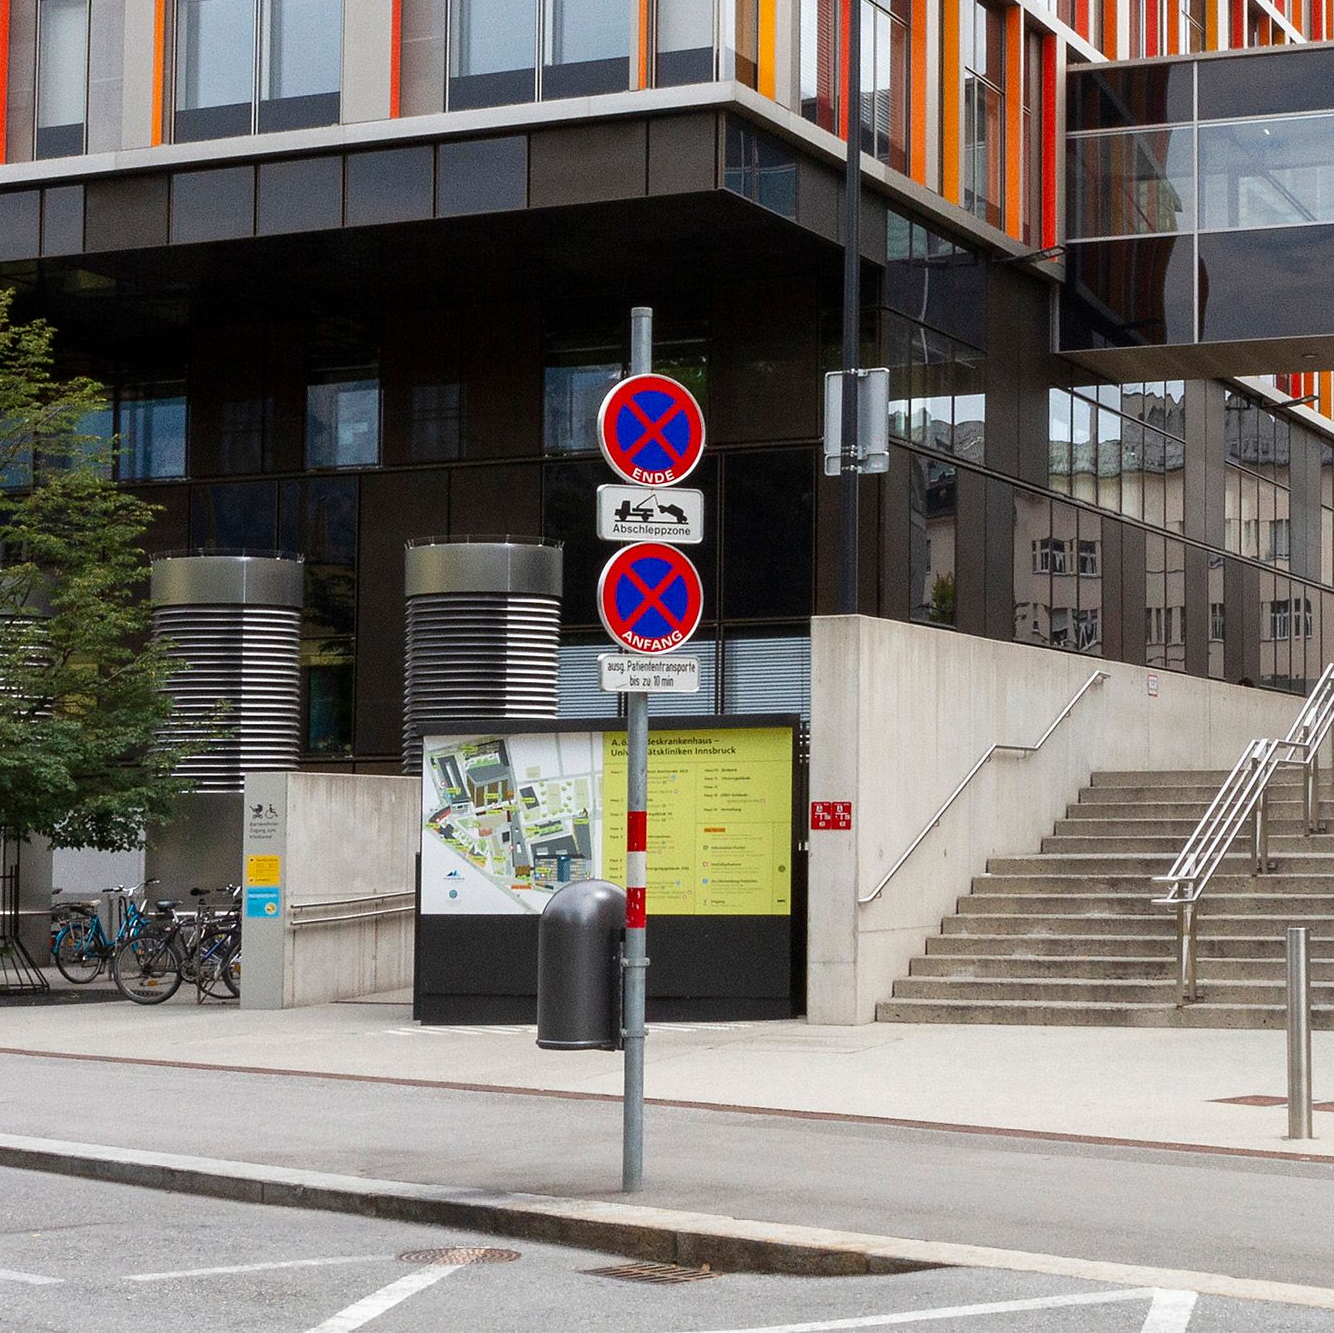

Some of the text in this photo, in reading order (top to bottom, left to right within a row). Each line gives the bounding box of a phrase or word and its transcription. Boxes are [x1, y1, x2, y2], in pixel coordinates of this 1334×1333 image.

[632, 467, 675, 484] ENDE
[612, 523, 691, 536] Abschleppzone
[622, 630, 683, 651] ANFANG
[607, 660, 696, 674] ausg. Patiententransporte
[629, 675, 641, 686] bis
[642, 677, 652, 686] zu
[653, 676, 661, 686] 10
[695, 746, 736, 755] Innsbruck
